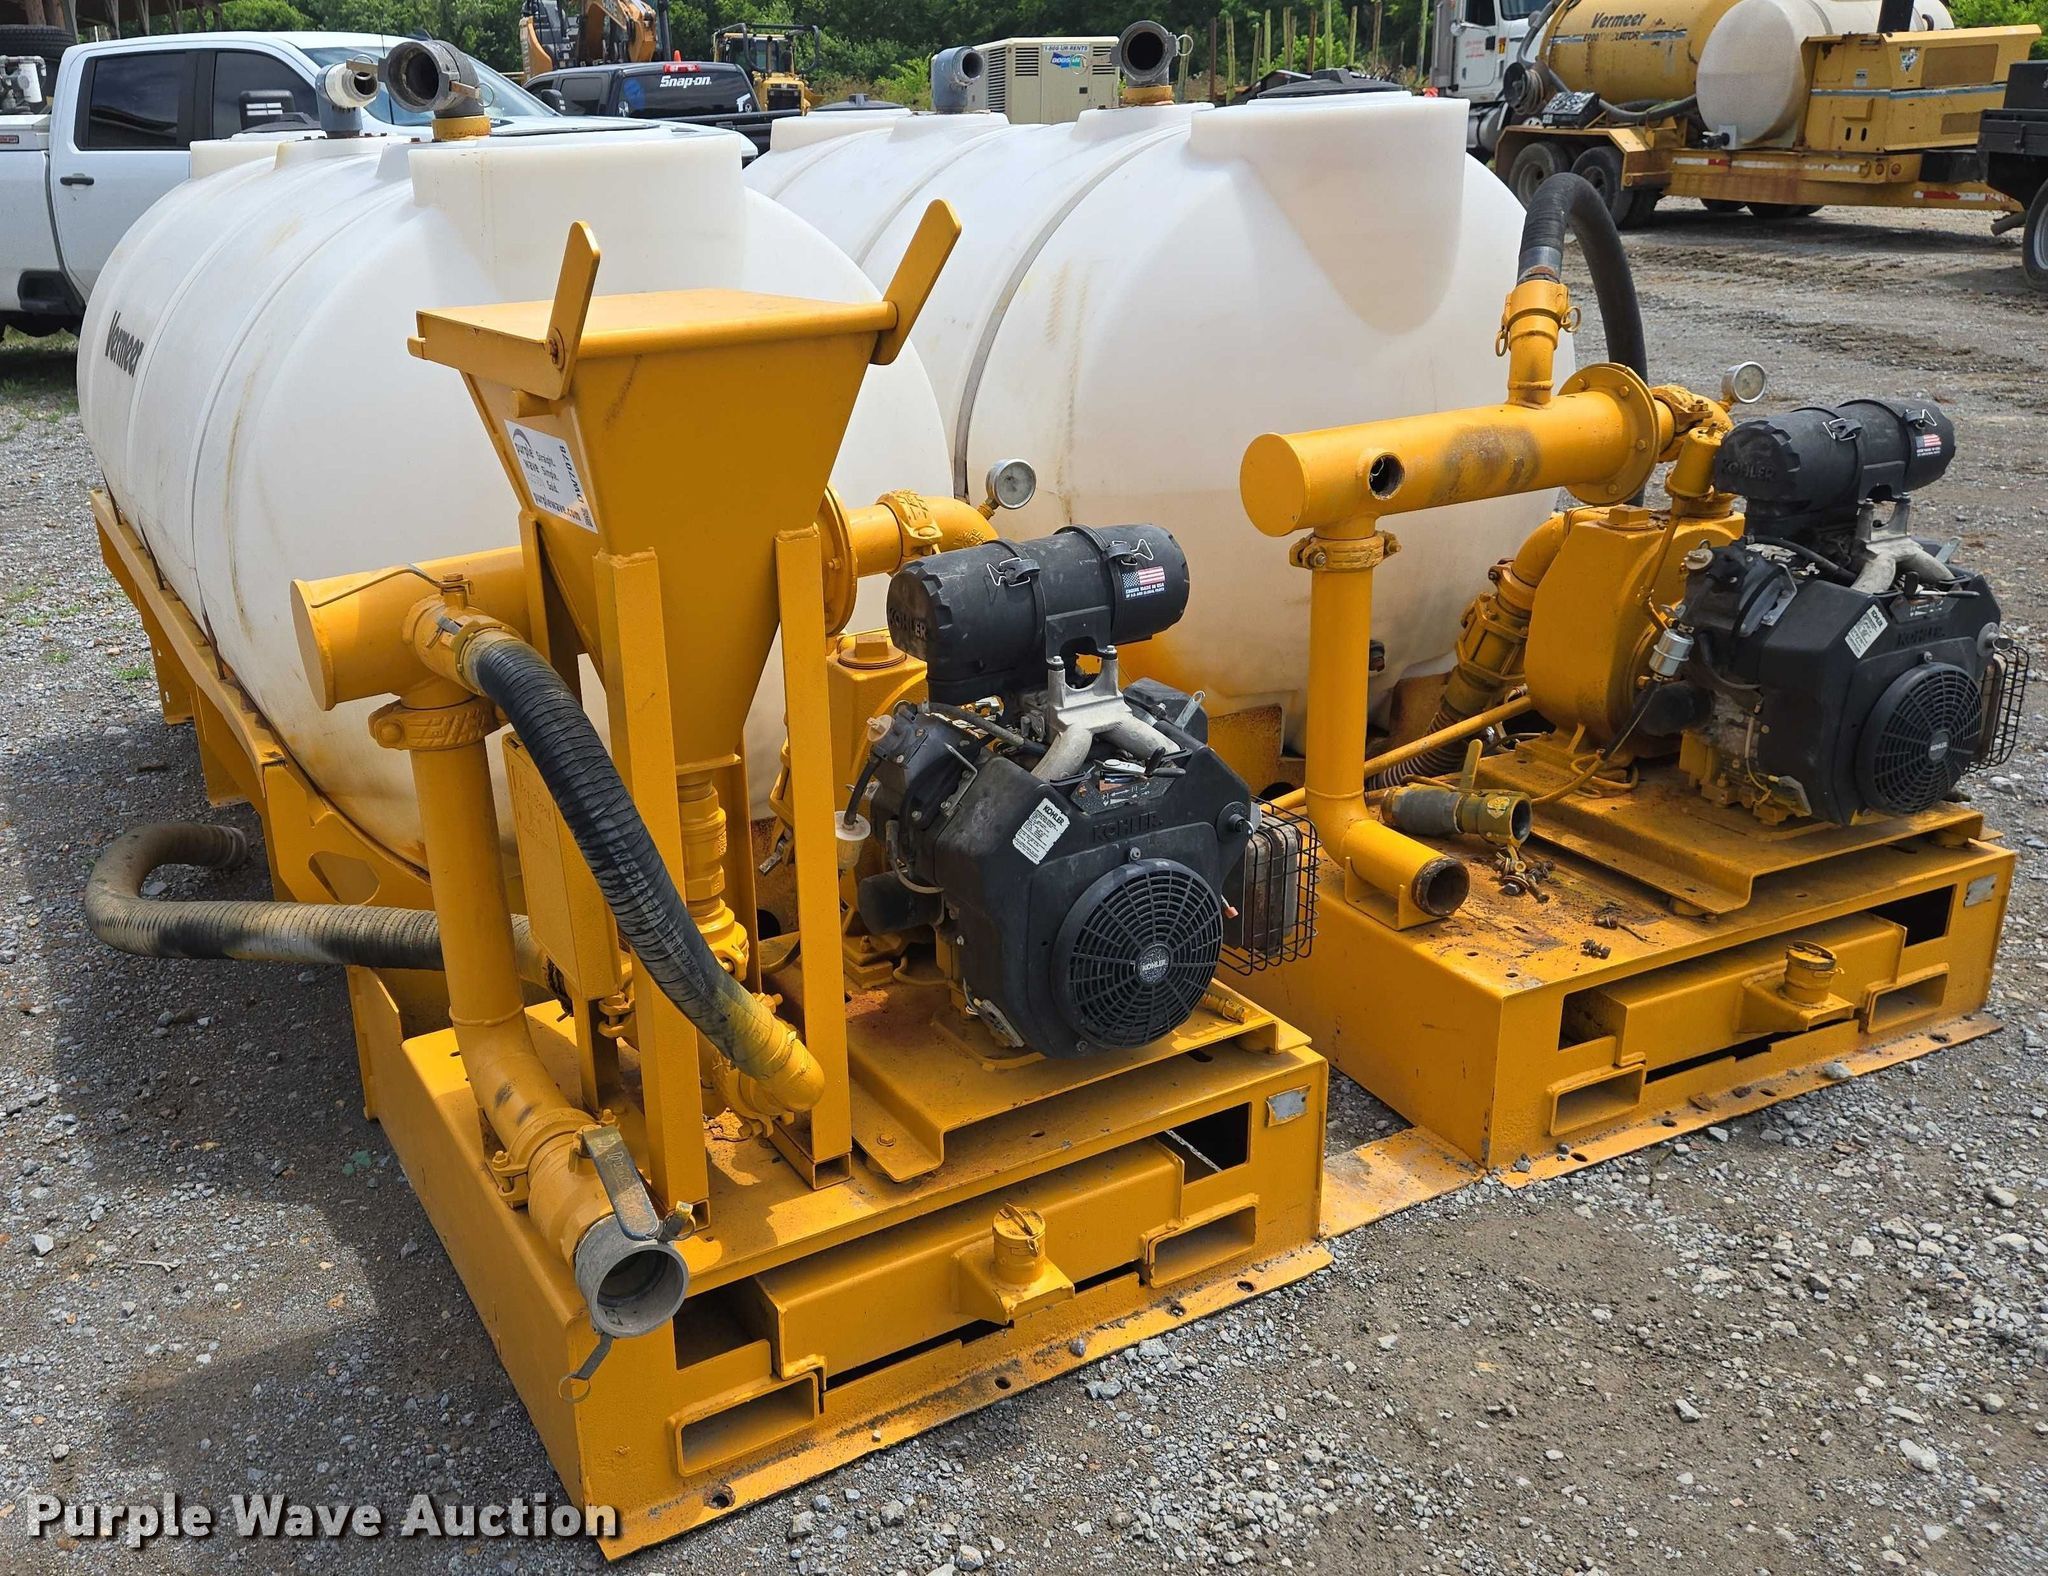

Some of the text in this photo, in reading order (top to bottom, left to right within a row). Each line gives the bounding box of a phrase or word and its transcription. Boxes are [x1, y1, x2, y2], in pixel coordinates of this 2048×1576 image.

[1591, 12, 1647, 28] Vermeer
[660, 75, 711, 88] Snap-on
[105, 310, 144, 378] Vermeer
[889, 607, 928, 640] KOHLER
[1043, 805, 1065, 826] KOHLER
